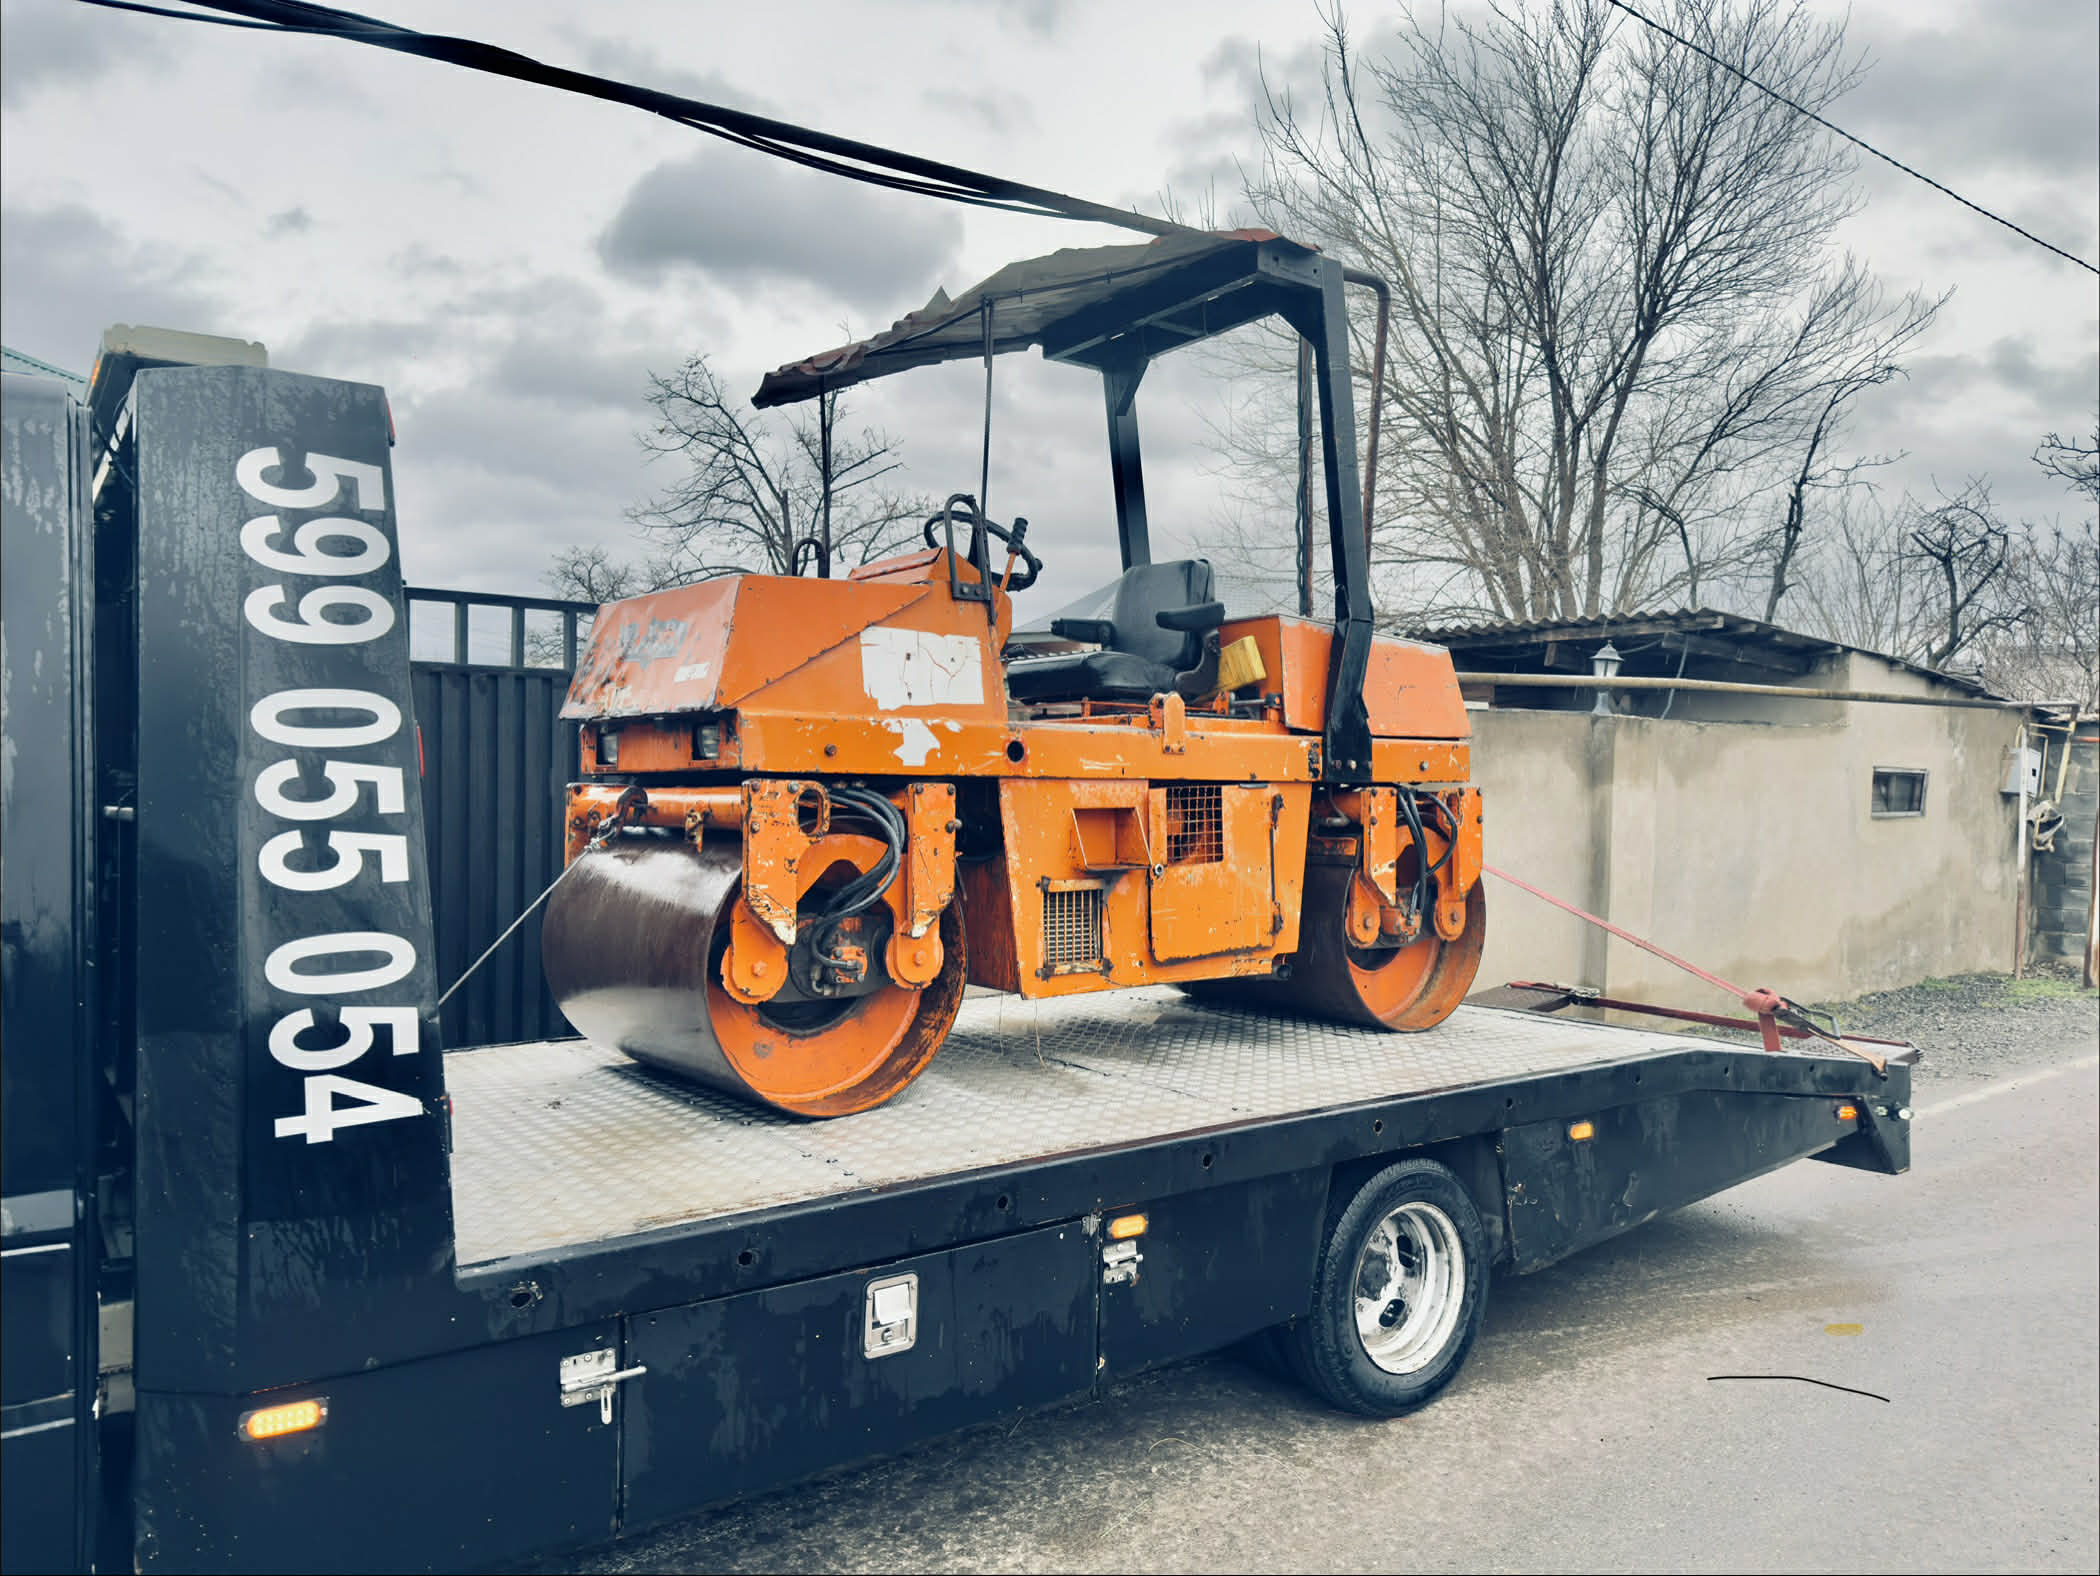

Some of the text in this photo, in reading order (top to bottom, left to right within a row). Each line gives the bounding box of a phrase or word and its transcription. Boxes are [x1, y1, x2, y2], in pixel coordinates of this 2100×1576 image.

[235, 446, 424, 1144] 599 055 054
